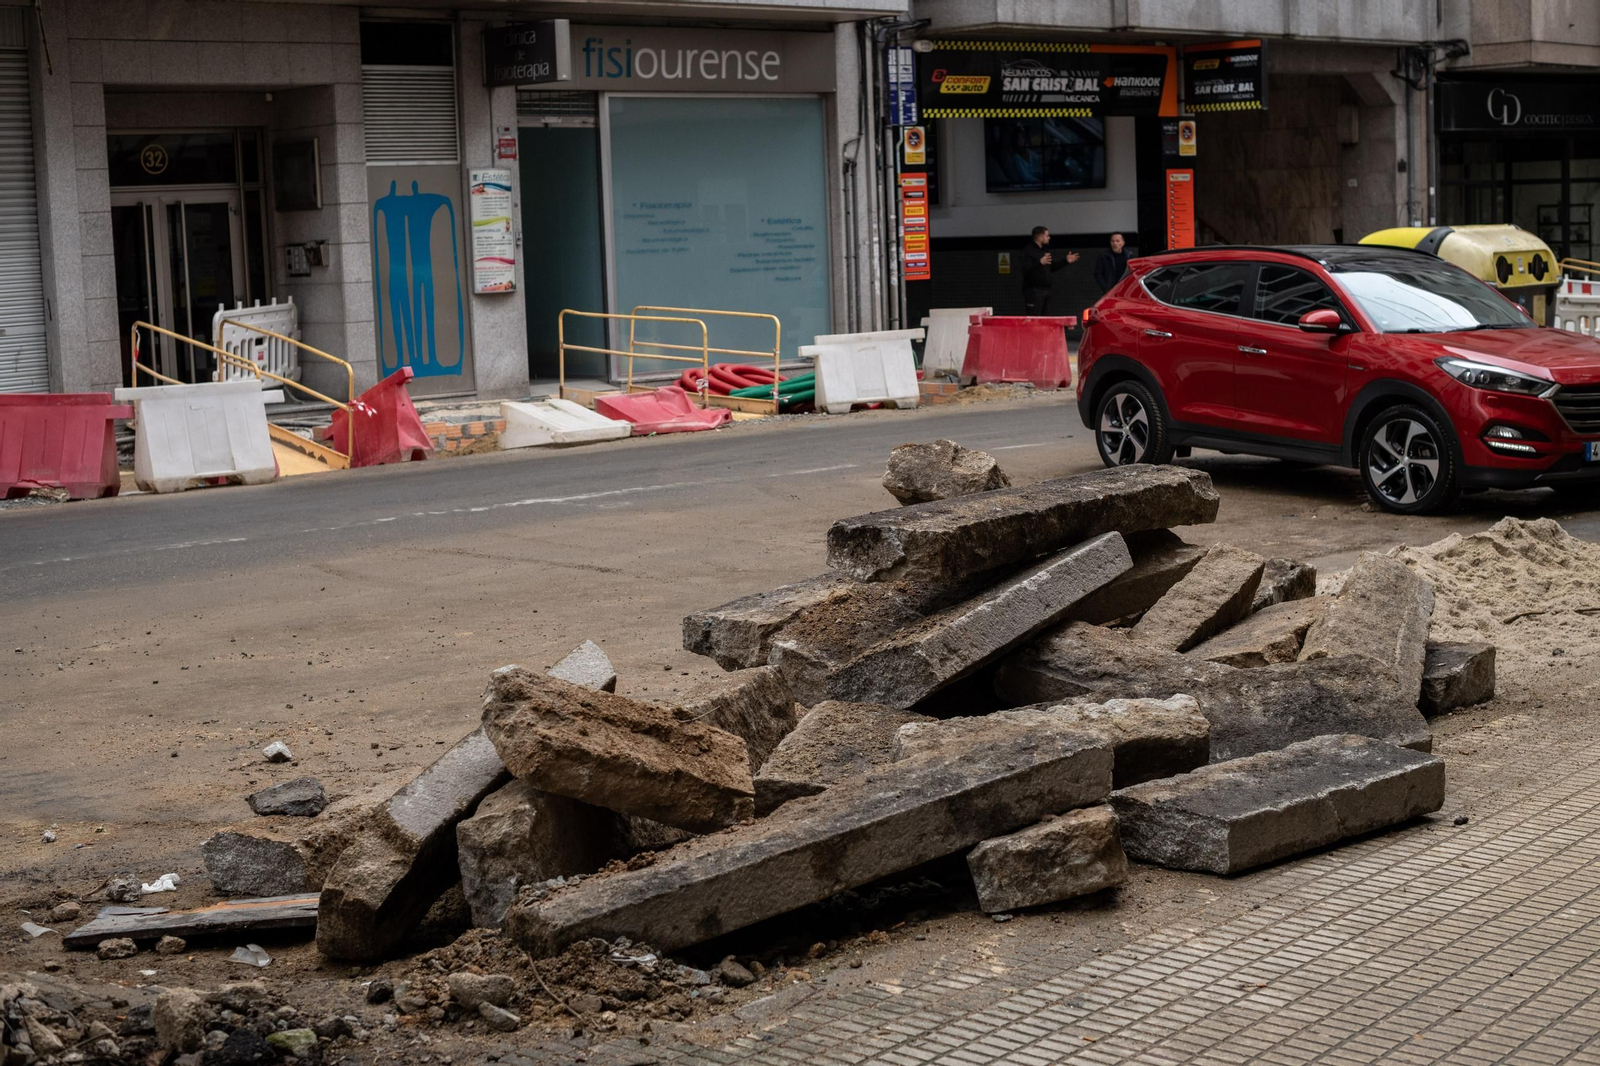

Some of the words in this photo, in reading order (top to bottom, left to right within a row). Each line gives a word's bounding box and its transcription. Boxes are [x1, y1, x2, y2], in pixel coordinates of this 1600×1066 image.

[582, 37, 780, 80] fisiourense
[494, 60, 550, 81] fisioterapia
[962, 84, 984, 92] auto
[1002, 77, 1030, 92] SAN
[1032, 77, 1100, 92] CRISTBAL
[1194, 85, 1211, 95] SAN
[1212, 82, 1255, 94] CRISTBAL
[145, 151, 163, 167] 32
